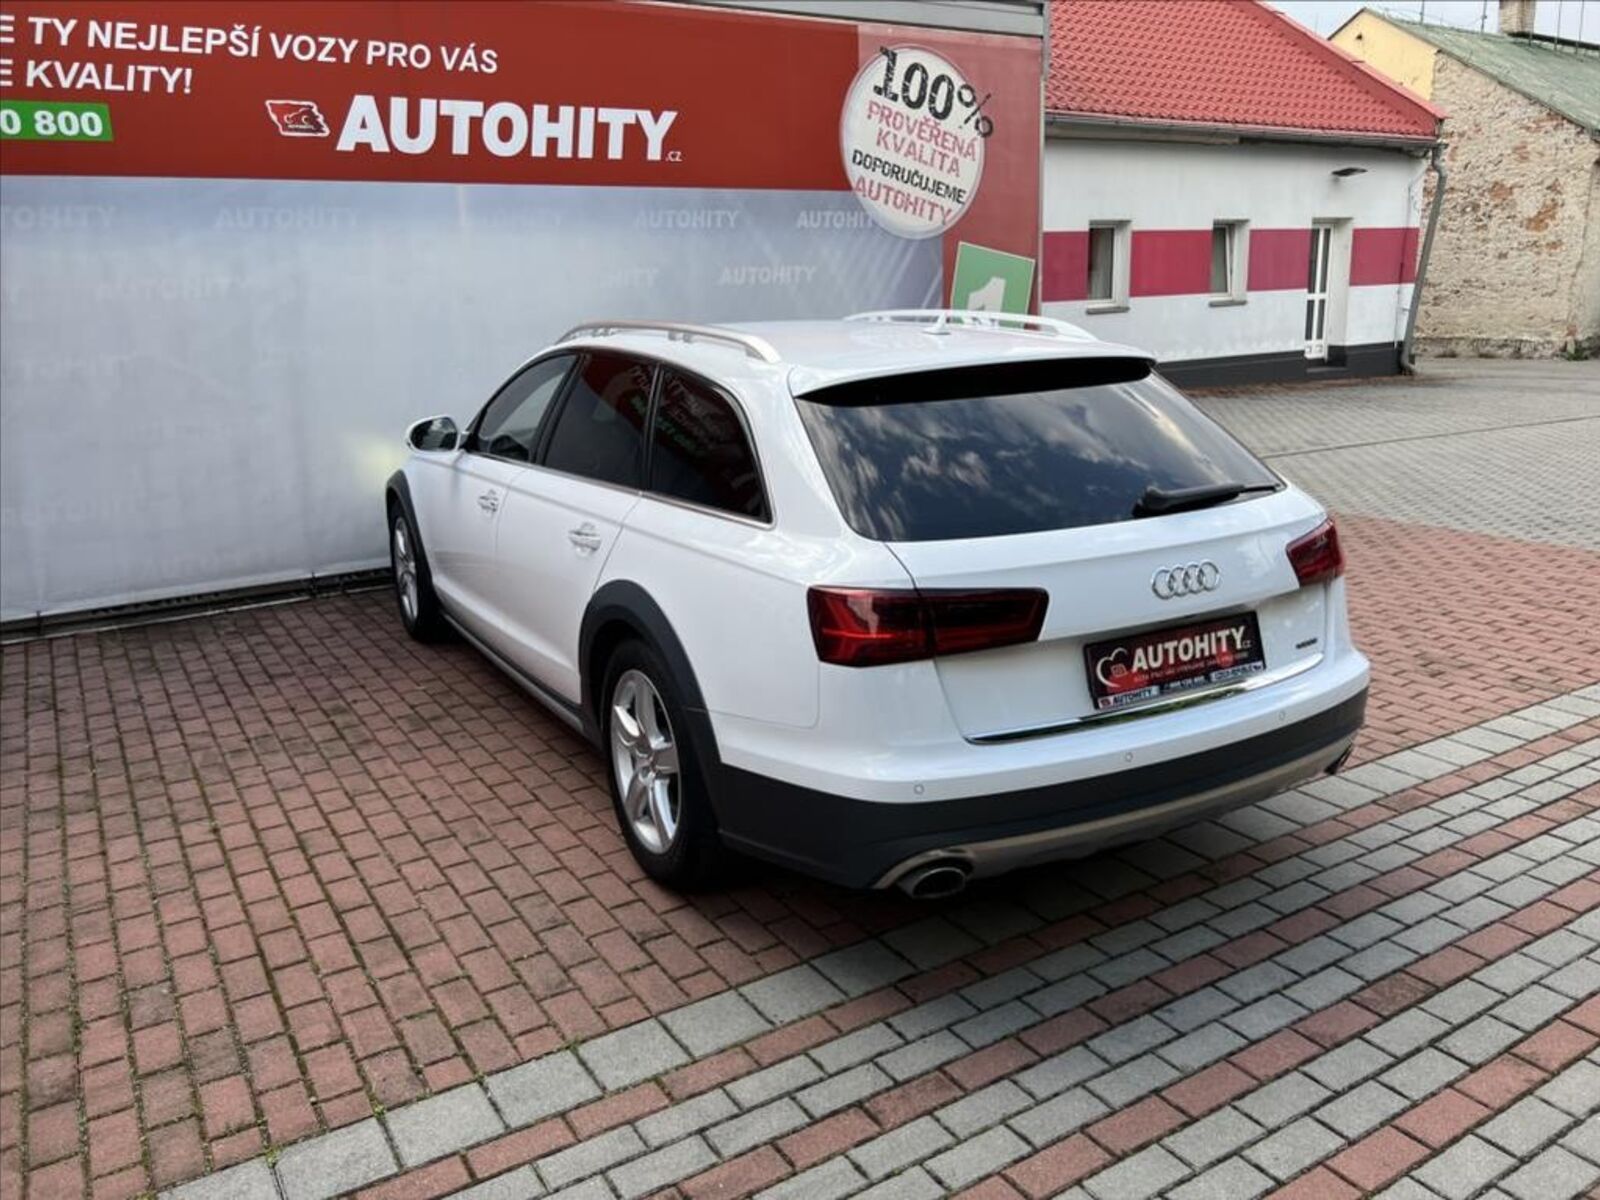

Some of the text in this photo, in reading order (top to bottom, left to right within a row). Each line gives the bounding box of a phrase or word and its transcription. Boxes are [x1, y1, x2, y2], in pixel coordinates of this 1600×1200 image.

[28, 16, 77, 46] TY
[87, 20, 262, 57] NEJLEPŠÍ
[269, 32, 358, 63] VOZY
[366, 40, 431, 69] PRO
[440, 42, 498, 73] VÁS
[26, 60, 192, 94] KVALITY!
[873, 46, 993, 138] 100%
[34, 110, 103, 137] 800
[336, 95, 678, 161] AUTOHITY
[867, 101, 977, 161] PROVĚŘENÁ
[852, 149, 966, 205] DOPORUČUJEME
[876, 127, 960, 178] KVALITA
[855, 176, 953, 226] AUTOHITY
[719, 265, 817, 286] AUTOHITY
[1131, 625, 1245, 673] AUTOHITY
